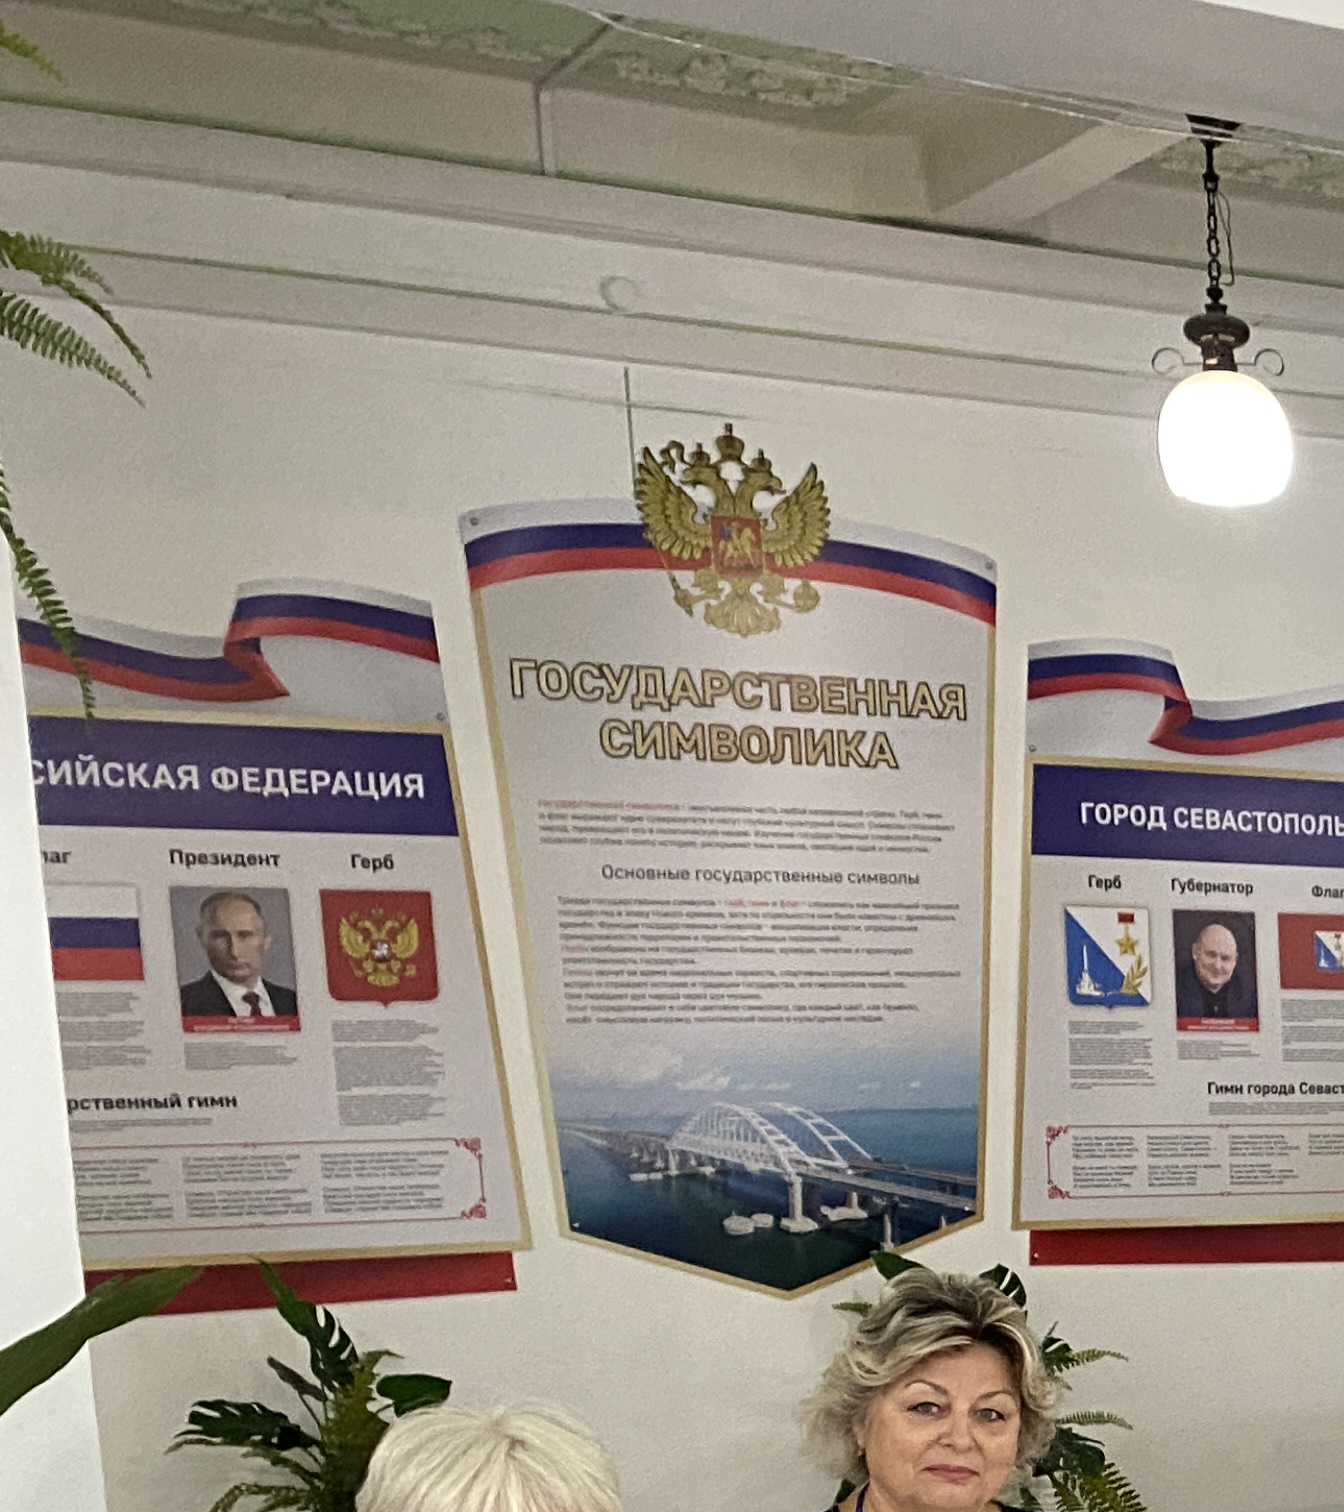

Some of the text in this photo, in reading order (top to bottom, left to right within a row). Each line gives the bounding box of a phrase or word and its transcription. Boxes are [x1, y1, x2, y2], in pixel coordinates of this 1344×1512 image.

[510, 657, 967, 721] ГОСУДАРСТВЕННАЯ
[600, 720, 898, 769] СИМВОЛИКА
[32, 754, 425, 800] СИЙСКАЯ ФЕДЕРАЦИЯ
[1080, 801, 1167, 831] ГОРОД
[169, 849, 281, 869] Президент
[350, 853, 394, 872] Герб
[602, 864, 920, 885] Основные государственные символы
[1088, 874, 1121, 890] Герб
[1171, 878, 1253, 896] Губернатор
[1311, 885, 1344, 900] Флаг
[1207, 1082, 1243, 1096] Гимн
[1247, 1083, 1295, 1099] города
[188, 1096, 237, 1108] гимн
